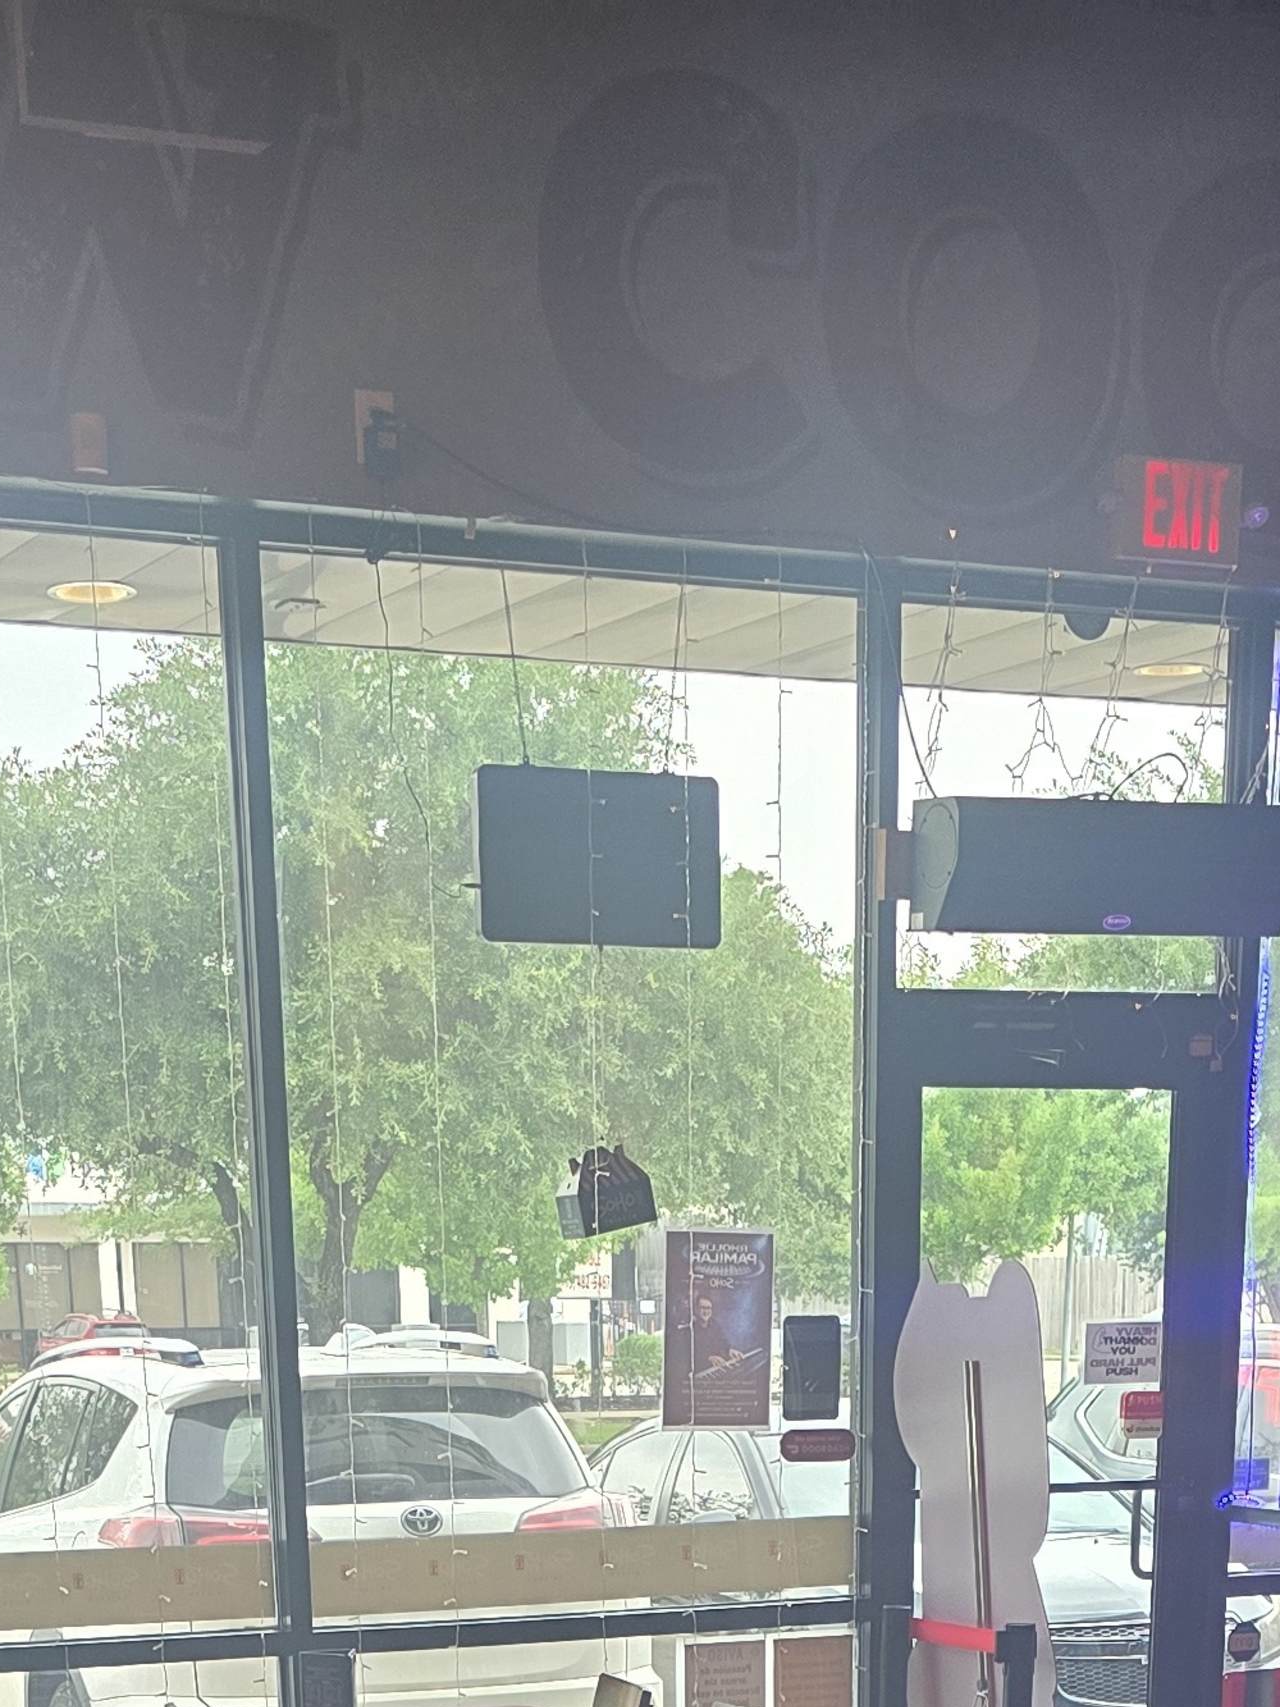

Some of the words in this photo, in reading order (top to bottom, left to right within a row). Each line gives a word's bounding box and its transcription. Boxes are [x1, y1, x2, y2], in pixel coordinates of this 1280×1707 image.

[1142, 459, 1231, 554] EXIT
[1111, 1346, 1137, 1356] YOU
[1105, 1367, 1139, 1377] PUSH
